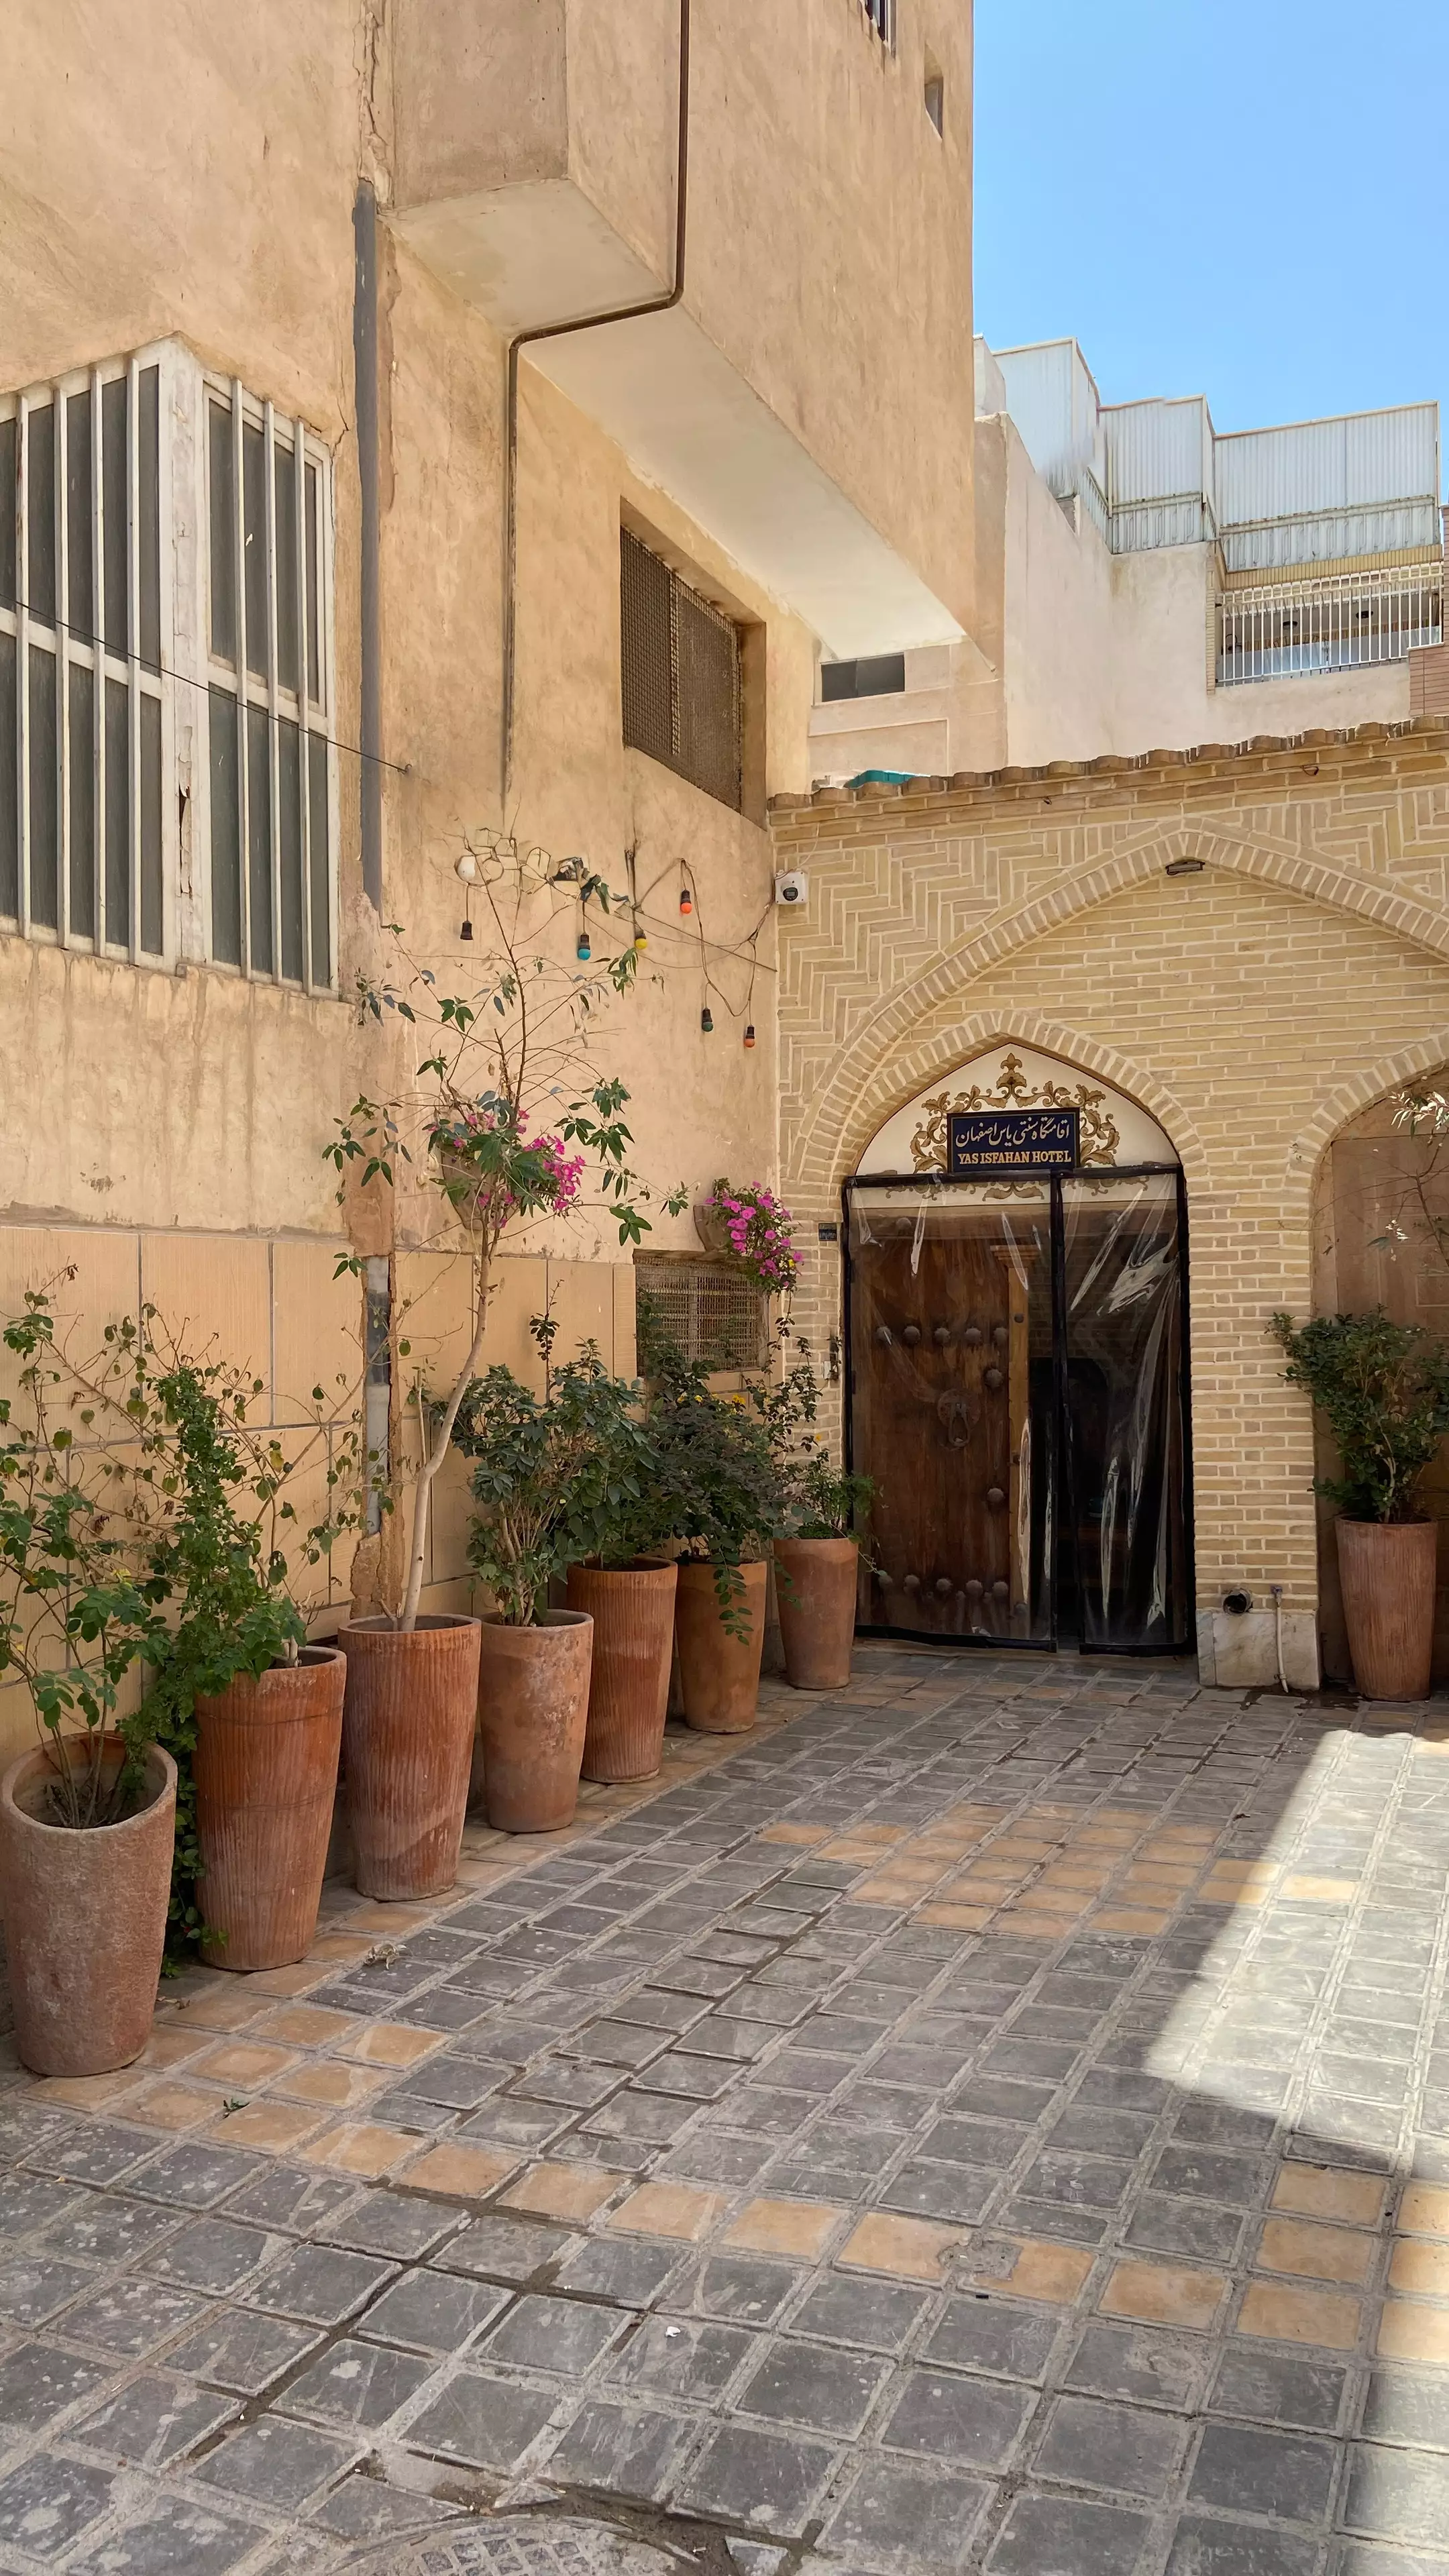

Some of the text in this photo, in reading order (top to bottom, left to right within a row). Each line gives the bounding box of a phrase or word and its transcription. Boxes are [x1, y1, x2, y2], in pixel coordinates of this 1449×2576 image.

[955, 1116, 1070, 1148] اقامتگاه سنتی یاس اصفهان
[957, 1150, 1072, 1165] YAS ISFAHAN HOTEL
